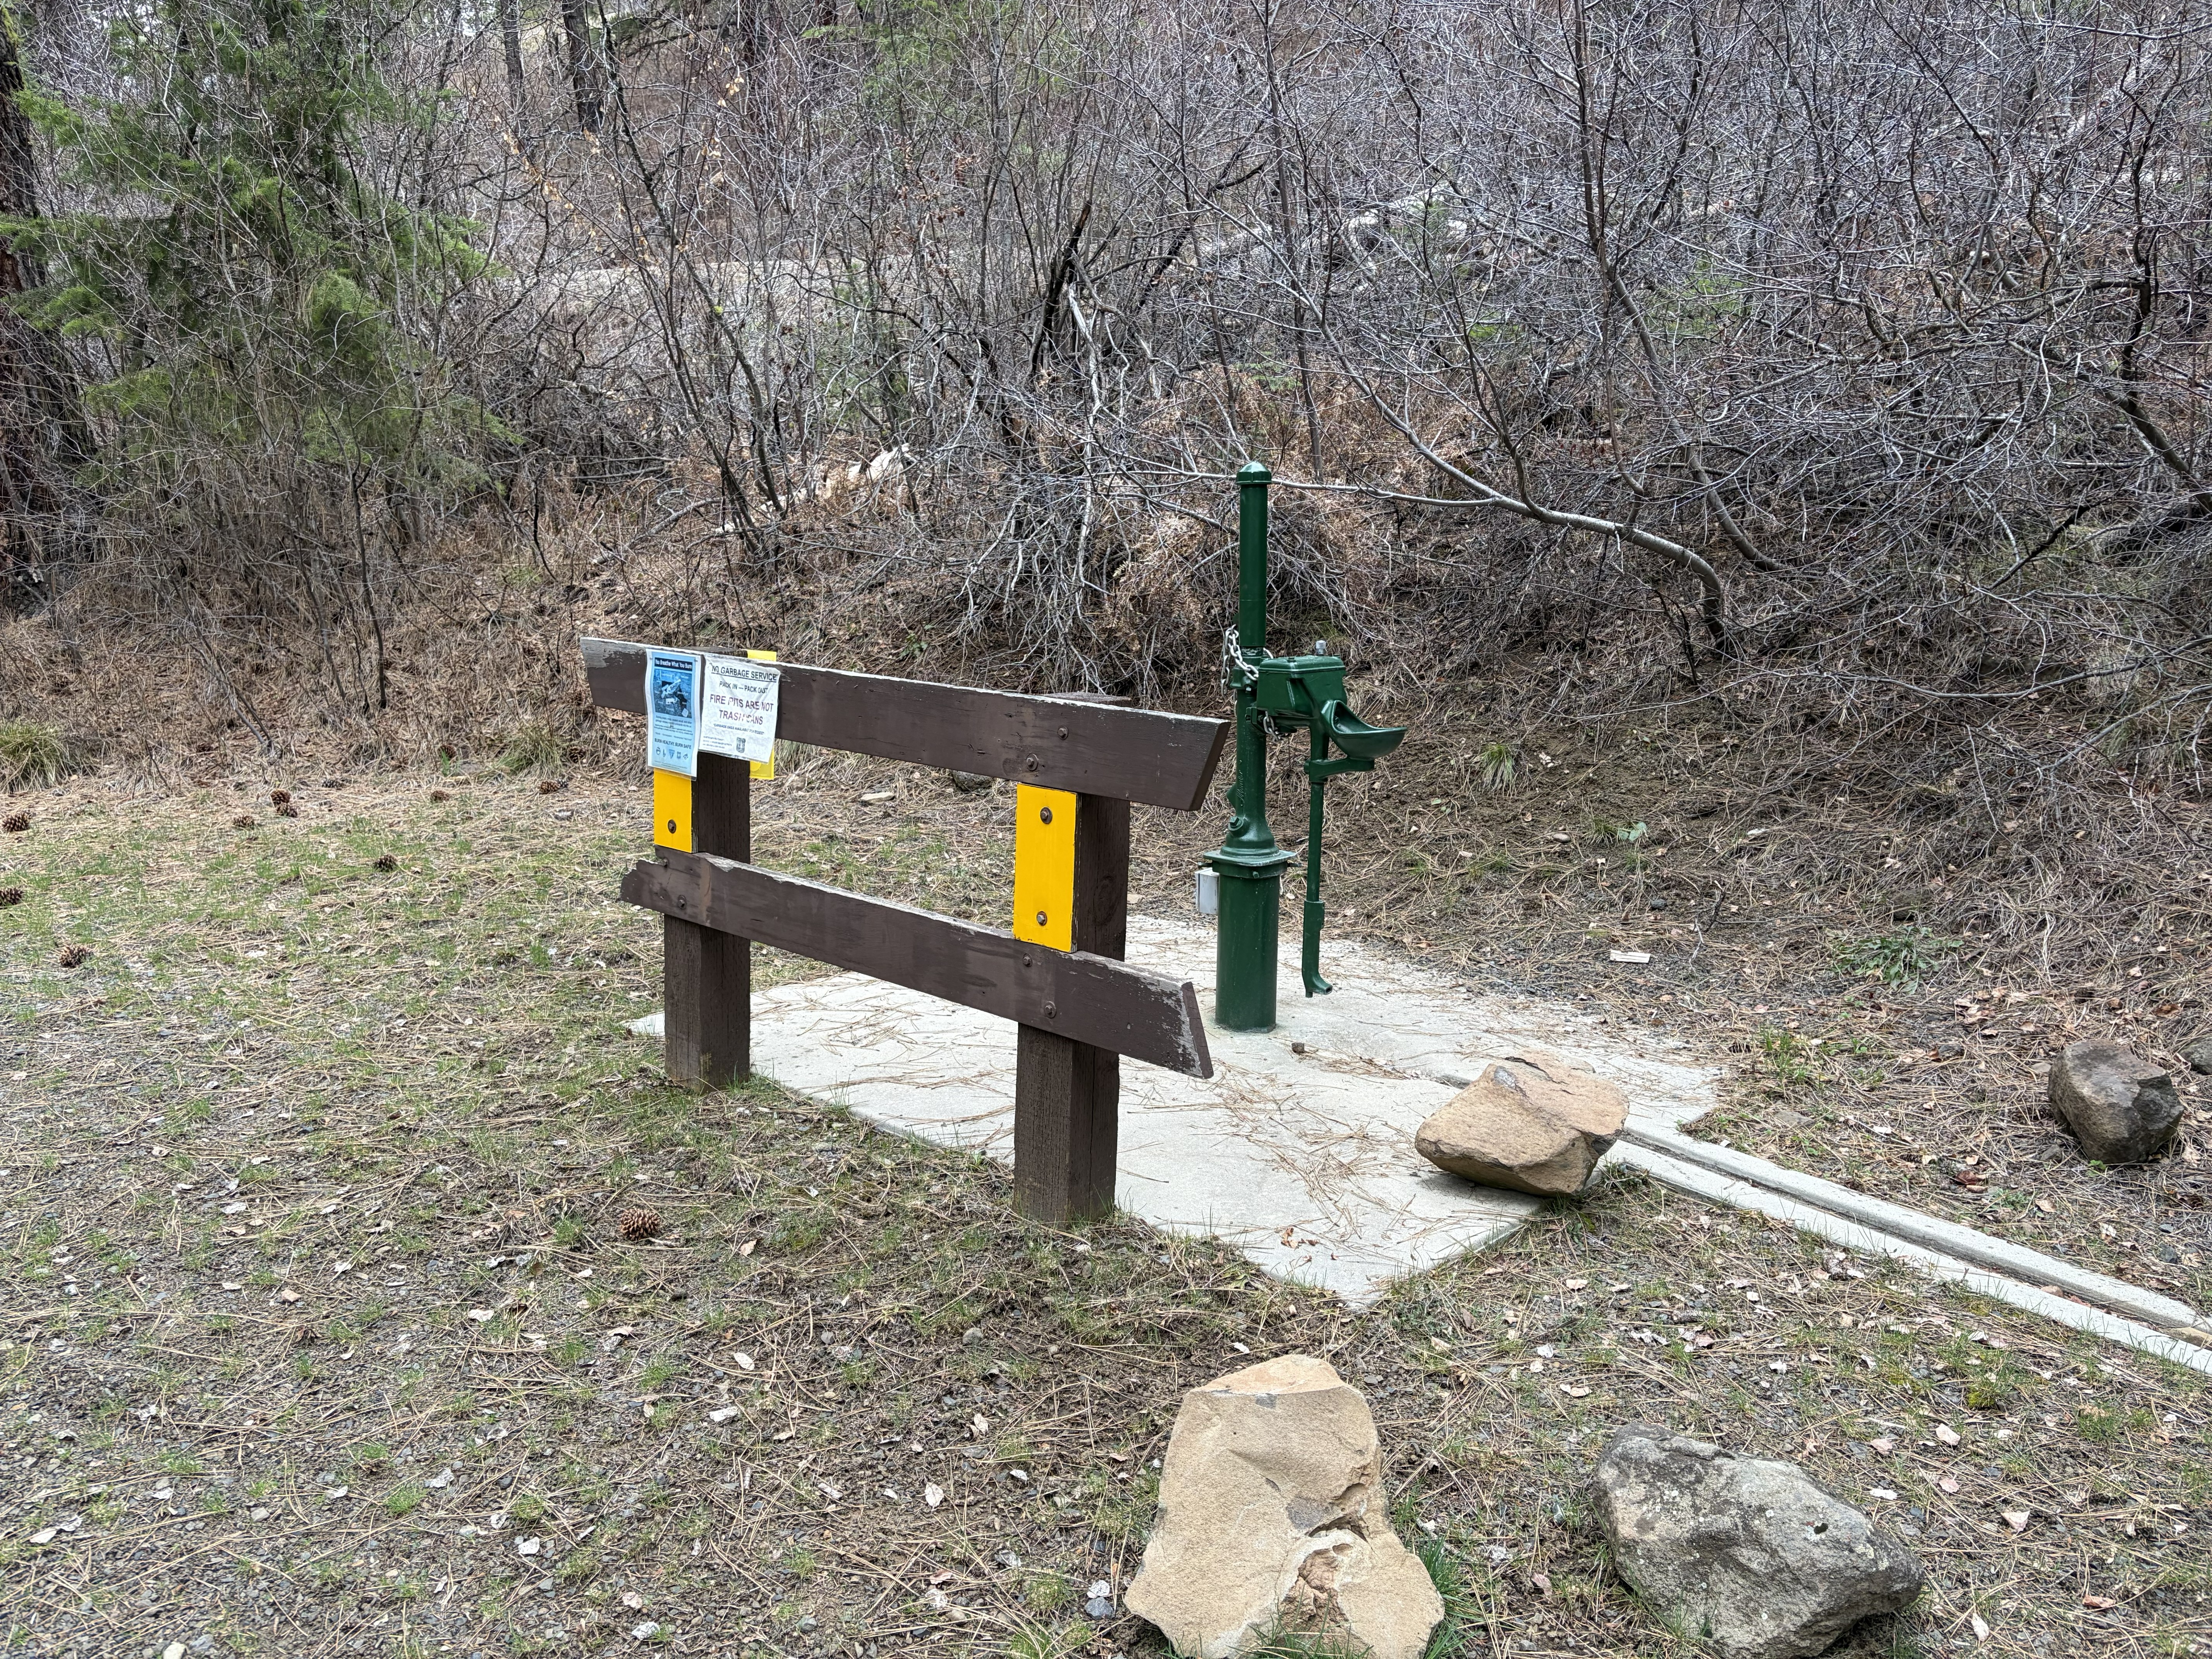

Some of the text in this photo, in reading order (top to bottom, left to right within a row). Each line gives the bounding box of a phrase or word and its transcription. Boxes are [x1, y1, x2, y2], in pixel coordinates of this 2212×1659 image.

[721, 666, 750, 678] GARBAGE
[751, 671, 777, 681] SERVICE
[719, 681, 731, 689] PACK
[710, 694, 774, 712] FIRE PITS ARE NOT
